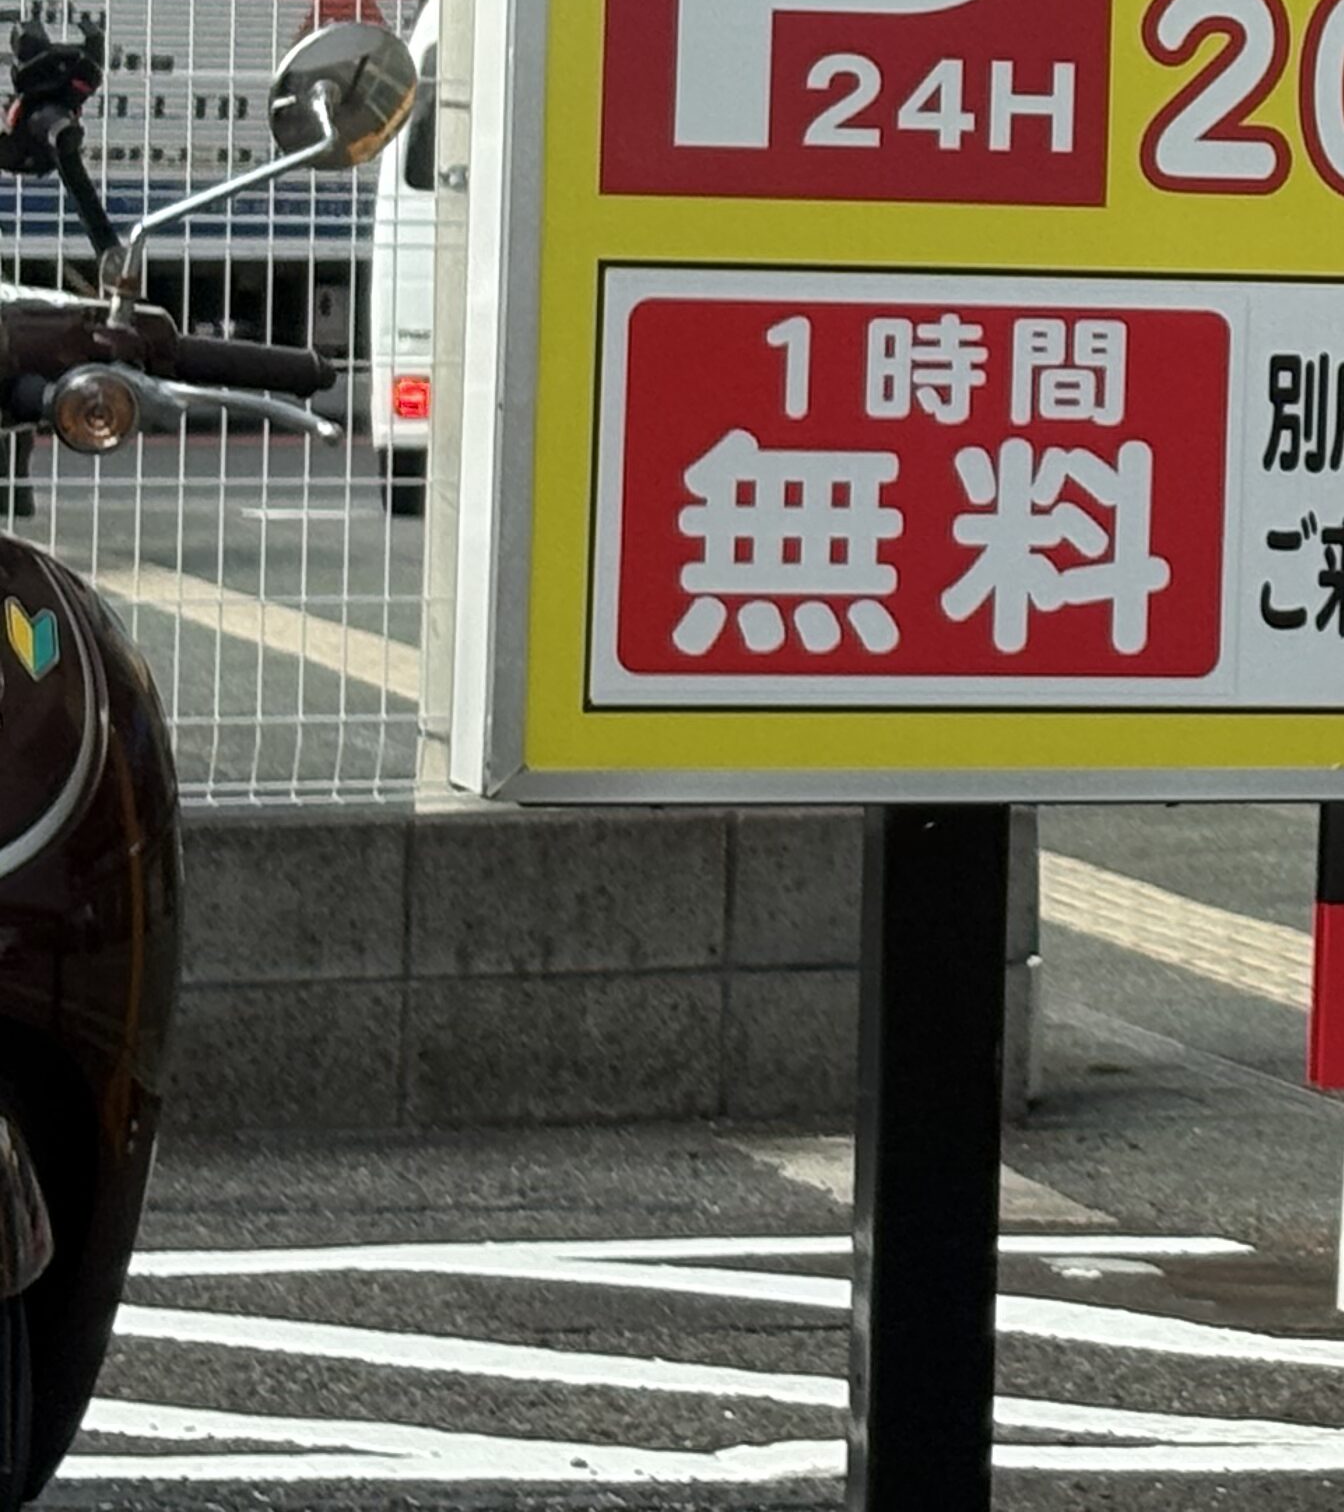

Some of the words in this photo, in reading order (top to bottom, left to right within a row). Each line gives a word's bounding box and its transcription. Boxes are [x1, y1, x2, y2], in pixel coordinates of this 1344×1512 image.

[802, 53, 1076, 153] 24H
[766, 312, 1129, 428] 1時間
[671, 428, 1171, 655] 無料
